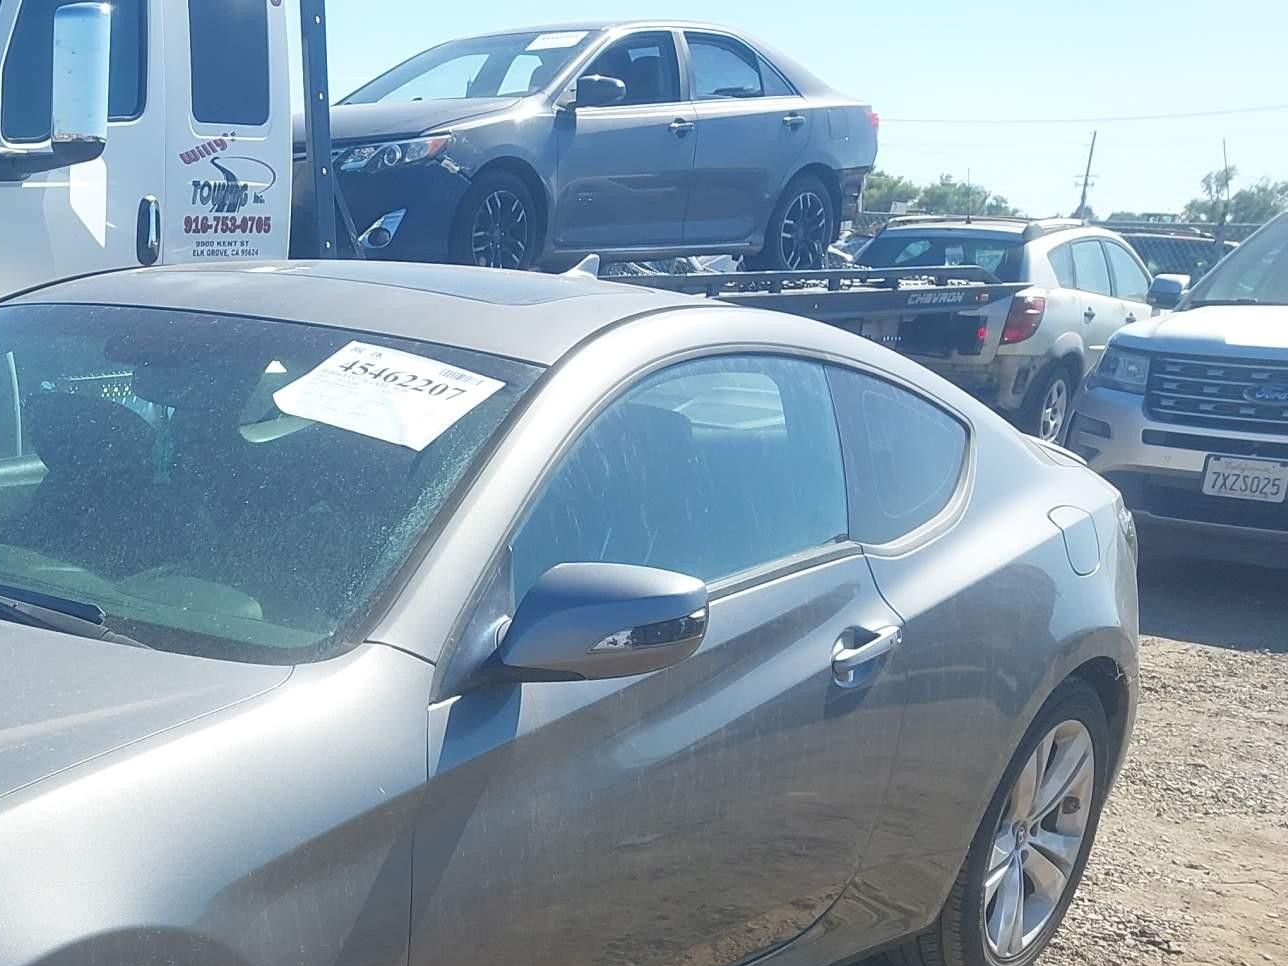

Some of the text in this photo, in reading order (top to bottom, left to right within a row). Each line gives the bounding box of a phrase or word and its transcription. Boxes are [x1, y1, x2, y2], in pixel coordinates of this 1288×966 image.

[183, 215, 272, 234] 916-753-0705
[192, 249, 205, 257] ELK
[231, 249, 240, 257] CA
[240, 249, 259, 257] 95624
[907, 292, 966, 305] CHEVRON
[339, 360, 467, 400] 45462207
[1211, 471, 1282, 496] 7XZS025
